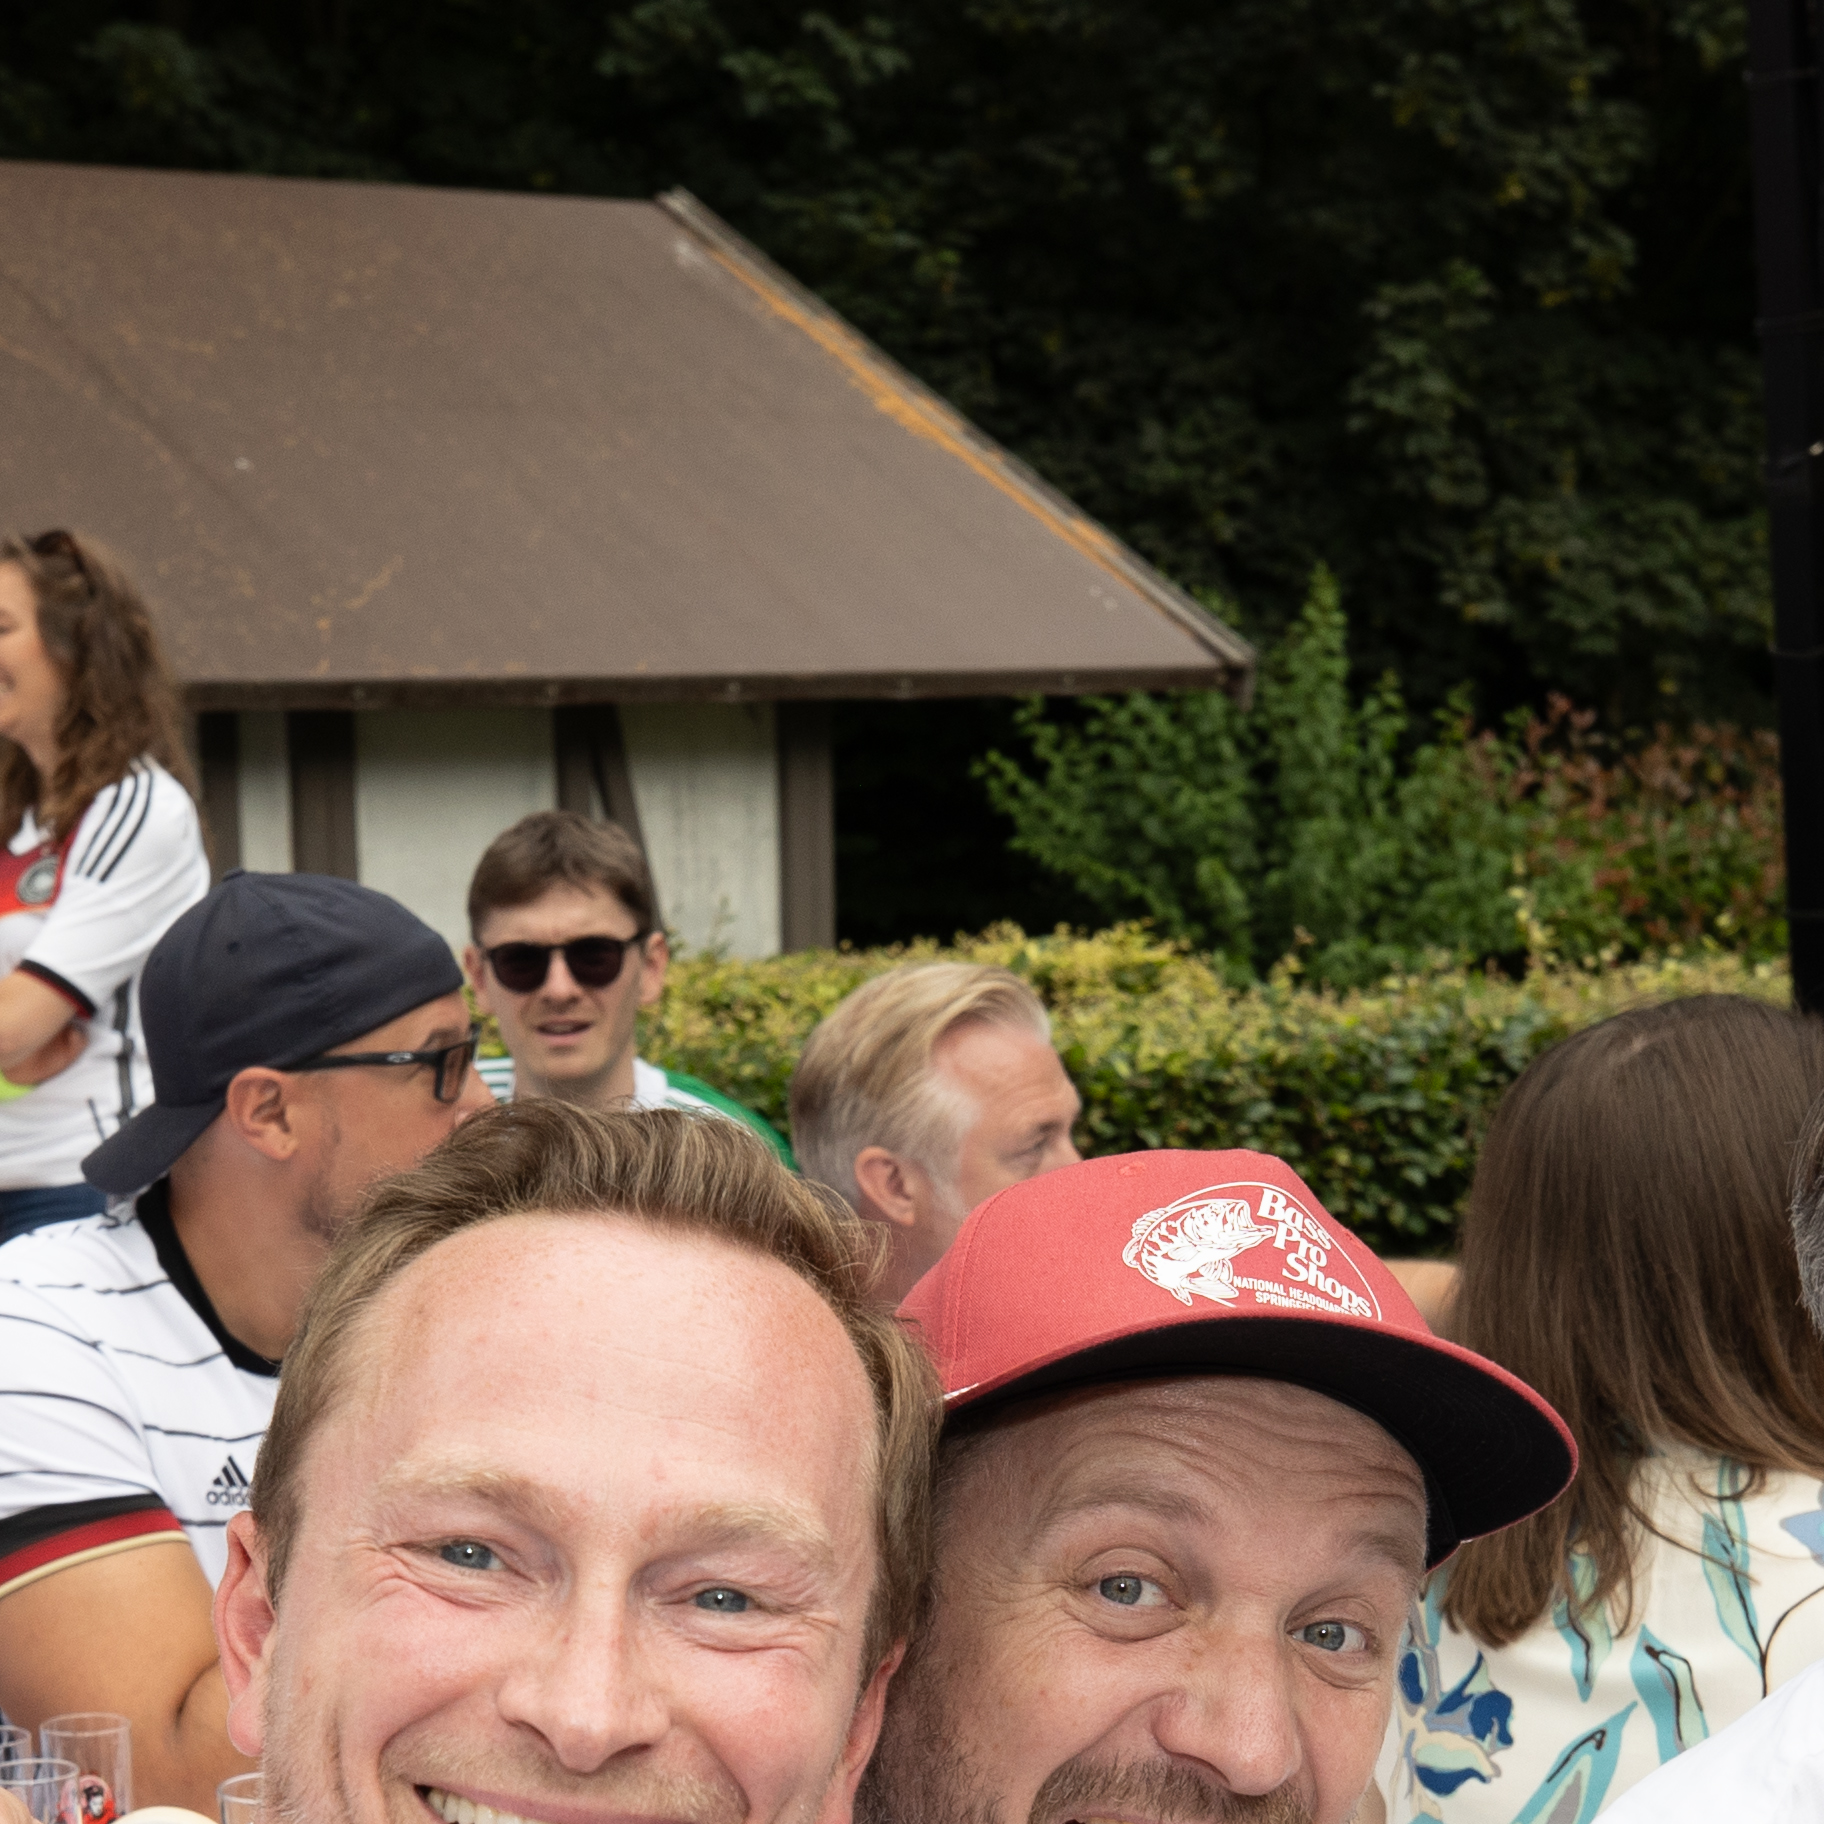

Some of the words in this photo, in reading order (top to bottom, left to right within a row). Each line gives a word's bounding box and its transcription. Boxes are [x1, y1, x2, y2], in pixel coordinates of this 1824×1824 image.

[1257, 1188, 1331, 1250] Bass
[1273, 1221, 1327, 1267] Pro
[1233, 1276, 1286, 1296] NATIONAL
[1282, 1253, 1372, 1317] Shops
[206, 1488, 252, 1507] adid
